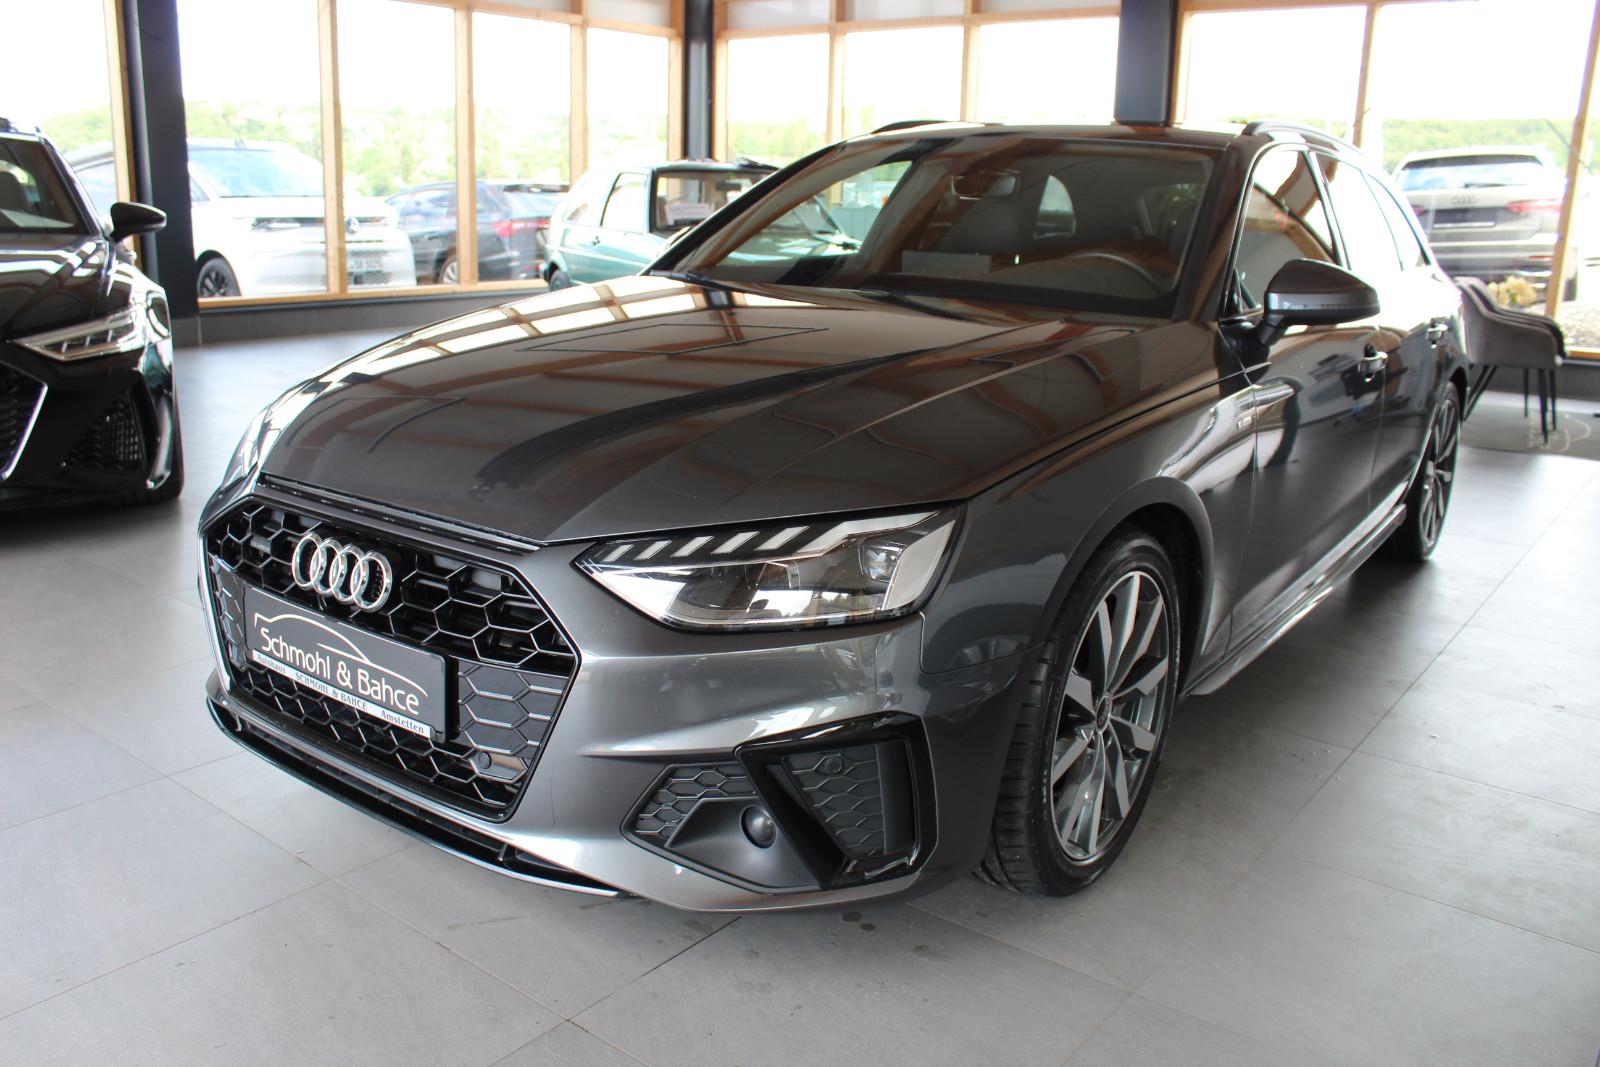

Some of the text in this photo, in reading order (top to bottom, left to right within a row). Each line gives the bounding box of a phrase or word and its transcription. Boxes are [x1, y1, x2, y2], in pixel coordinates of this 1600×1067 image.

[256, 653, 286, 674] Autohaus
[295, 672, 331, 696] SCHMOHL
[340, 692, 368, 711] BAHCE
[380, 709, 425, 734] Amstetten
[261, 627, 419, 715] Schmohl & Bahce
